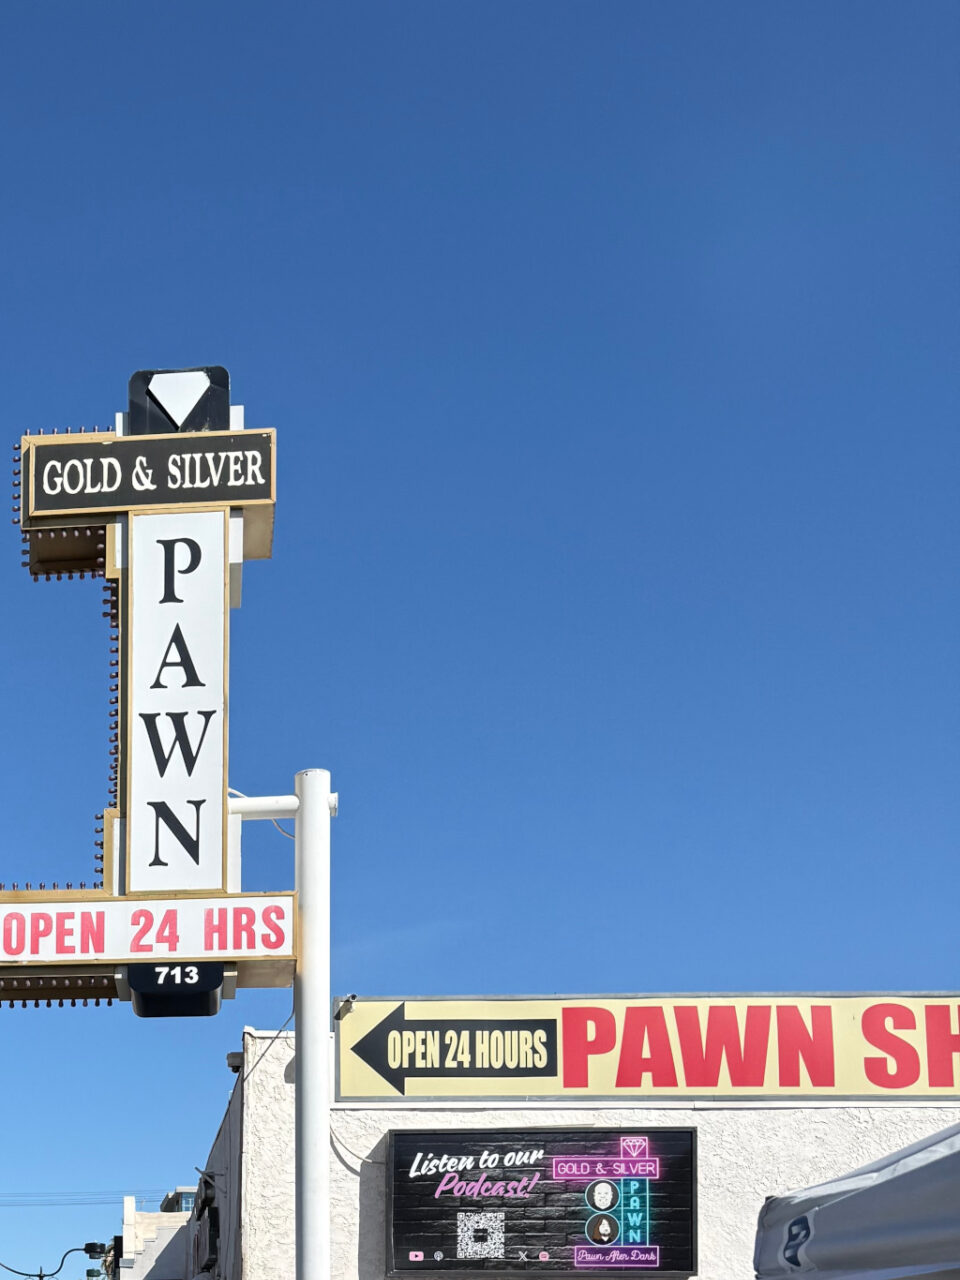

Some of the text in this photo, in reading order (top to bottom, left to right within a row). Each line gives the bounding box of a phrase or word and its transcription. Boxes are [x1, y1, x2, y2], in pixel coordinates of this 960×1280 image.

[42, 449, 266, 496] GOLD & SILVER
[138, 536, 217, 868] PAWN
[2, 903, 287, 957] OPEN 24 HRS
[154, 965, 199, 986] 713
[386, 1029, 548, 1069] OPEN 24 HOURS
[560, 1004, 836, 1089] PAWN
[408, 1149, 544, 1178] Listen to our
[557, 1162, 655, 1175] GOLD & SILVER
[434, 1172, 541, 1199] Podcast!
[626, 1180, 643, 1243] PAWN
[577, 1249, 656, 1264] Pawn After Dark
